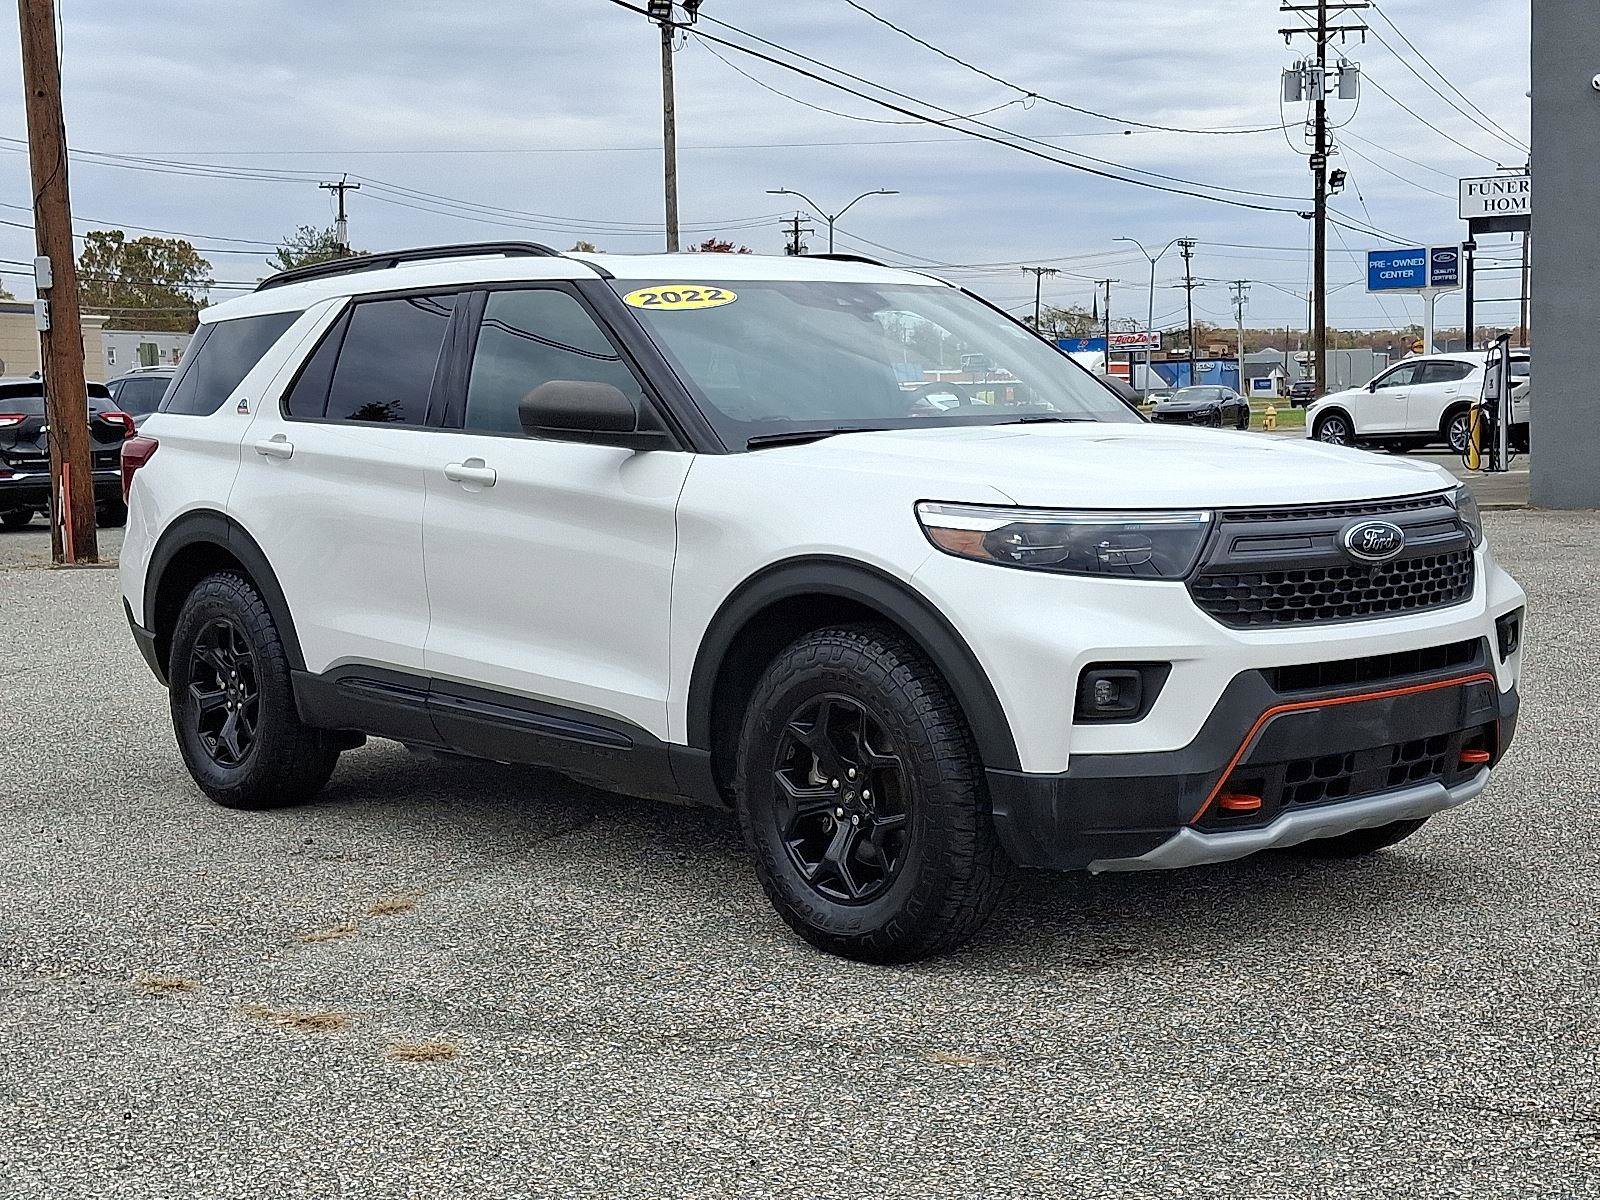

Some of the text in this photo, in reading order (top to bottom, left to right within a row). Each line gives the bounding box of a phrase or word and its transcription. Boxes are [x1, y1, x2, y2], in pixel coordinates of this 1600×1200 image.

[1484, 197, 1531, 211] HOM
[1369, 260, 1386, 269] PRE
[1392, 258, 1425, 267] OWNED
[1380, 270, 1414, 279] CENTER
[639, 289, 727, 306] 2022
[1115, 333, 1158, 345] AutoZoe
[1362, 528, 1395, 551] Ford
